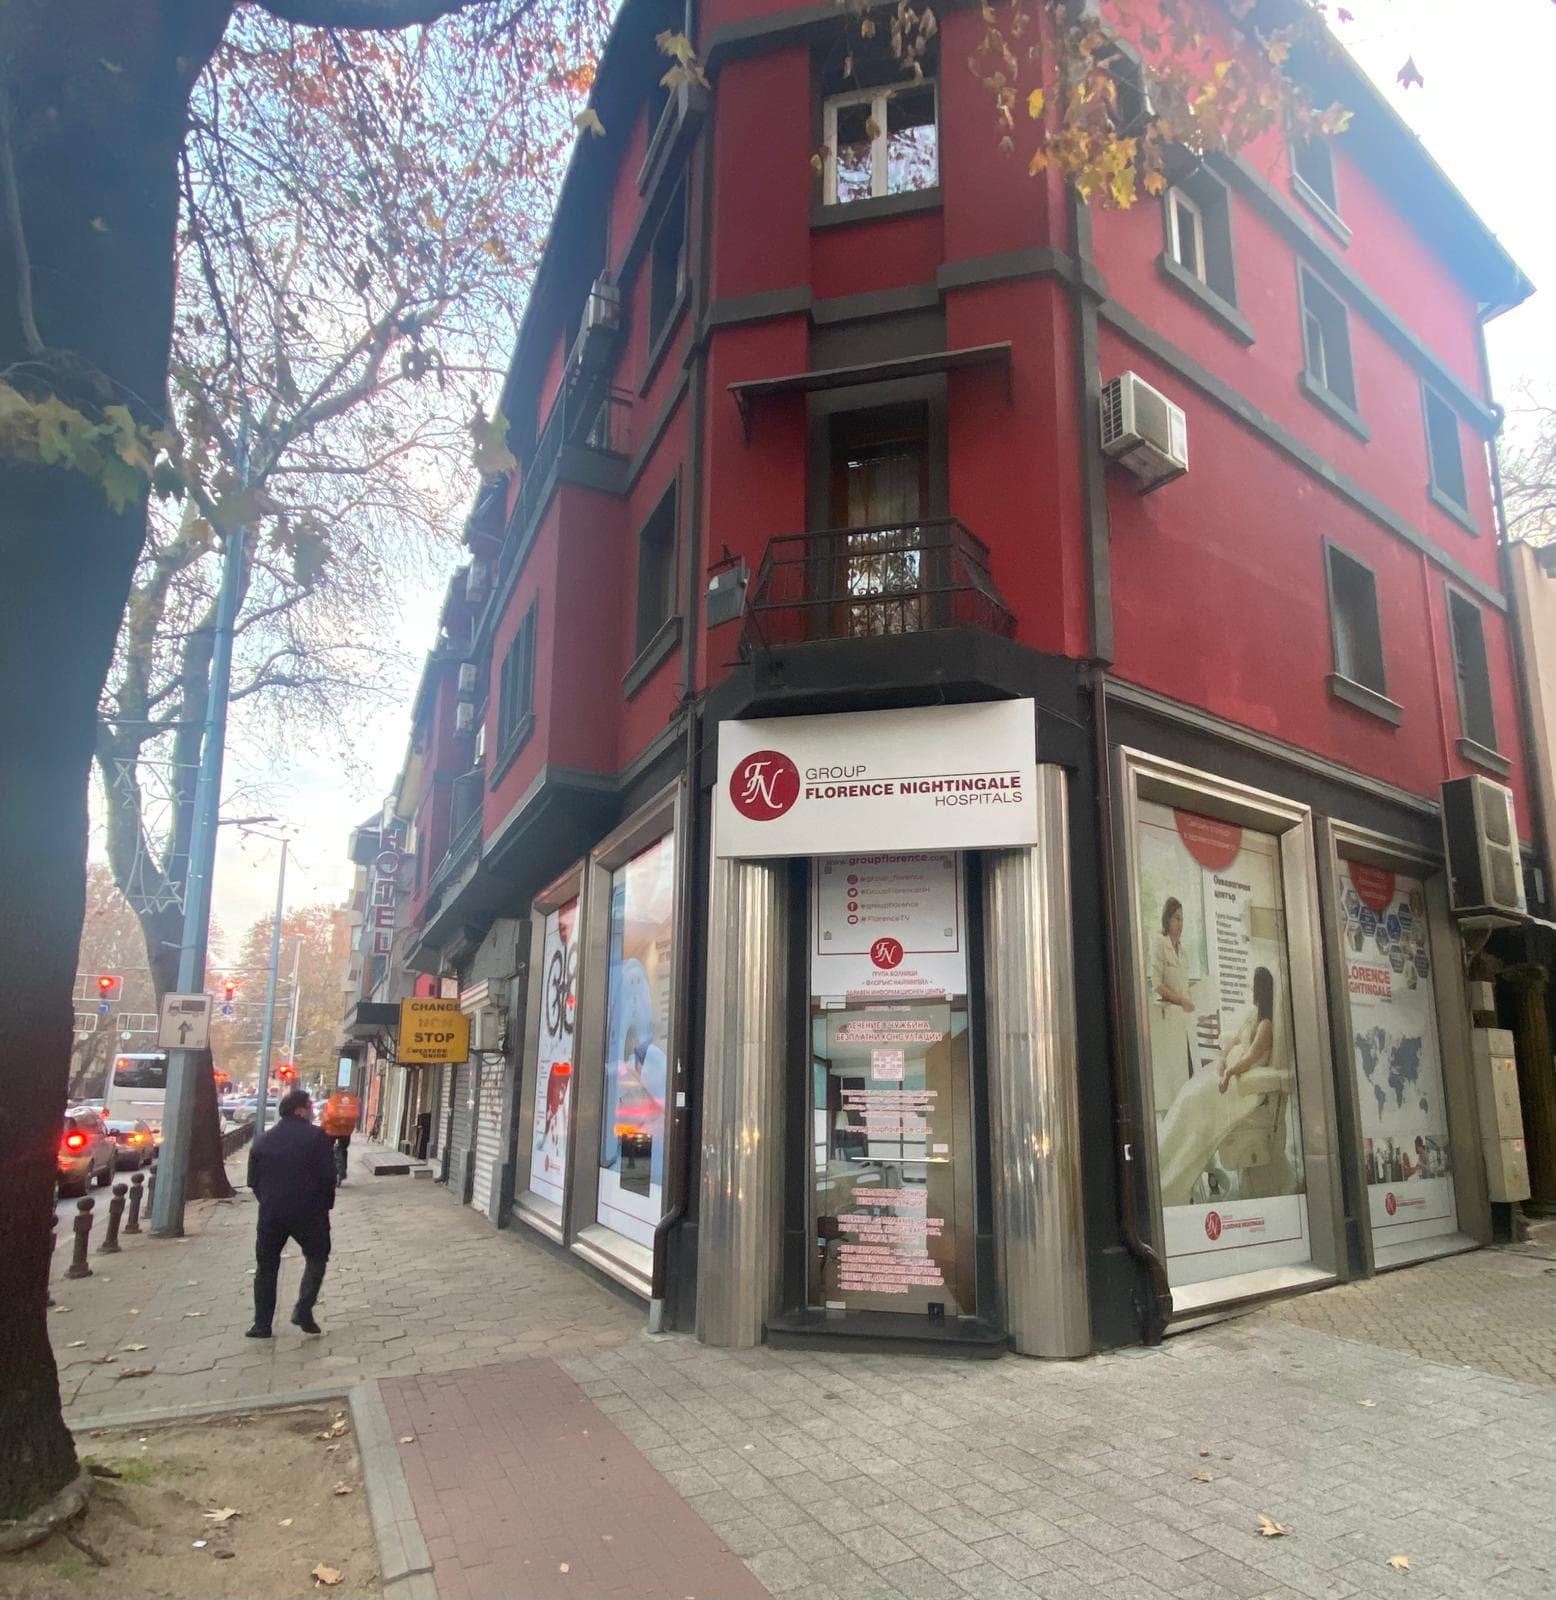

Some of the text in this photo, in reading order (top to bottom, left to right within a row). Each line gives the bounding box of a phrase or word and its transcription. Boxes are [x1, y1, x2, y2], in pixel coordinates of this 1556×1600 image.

[805, 765, 867, 780] GROUP
[805, 776, 1021, 800] FLORENCE NIGHTINGALE
[934, 791, 1023, 807] HOSPITALS
[411, 1003, 461, 1012] CHANGE
[414, 1032, 455, 1043] STOP
[836, 1033, 880, 1041] БЕЗПЛАТНИ
